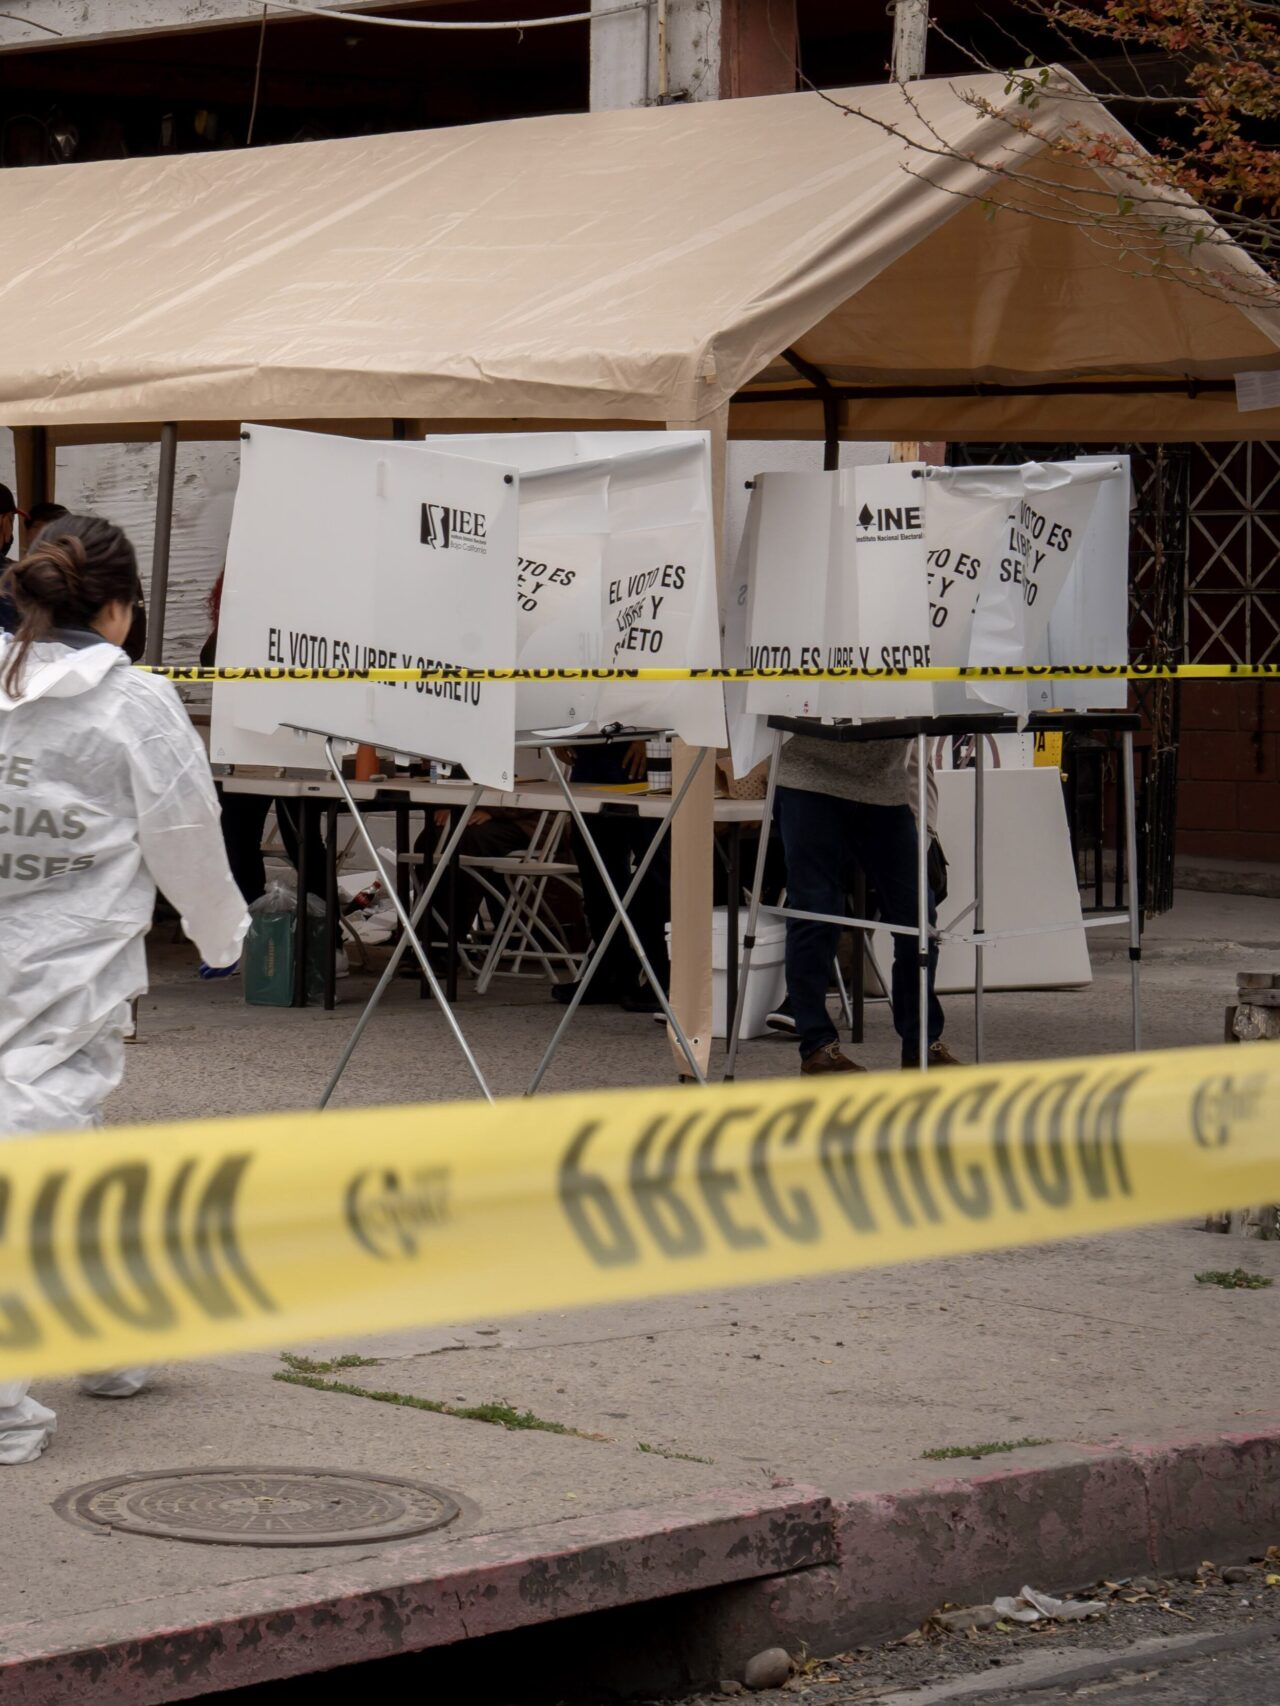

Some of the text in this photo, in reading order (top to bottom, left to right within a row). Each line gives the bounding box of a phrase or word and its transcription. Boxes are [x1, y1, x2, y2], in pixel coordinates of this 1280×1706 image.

[451, 508, 487, 538] IEE
[877, 506, 924, 531] INE
[1046, 522, 1072, 552] ES
[954, 553, 981, 580] ES
[1032, 550, 1046, 573] Y
[531, 581, 544, 595] Y
[548, 567, 577, 586] ES
[609, 579, 622, 605] EL
[661, 564, 686, 590] ES
[939, 577, 955, 598] Y
[651, 595, 664, 620] Y
[268, 627, 284, 664] EL
[289, 631, 328, 669] VOTO
[332, 639, 351, 669] ES
[750, 645, 791, 668] VOTO
[800, 647, 820, 668] ES
[859, 646, 870, 668] Y
